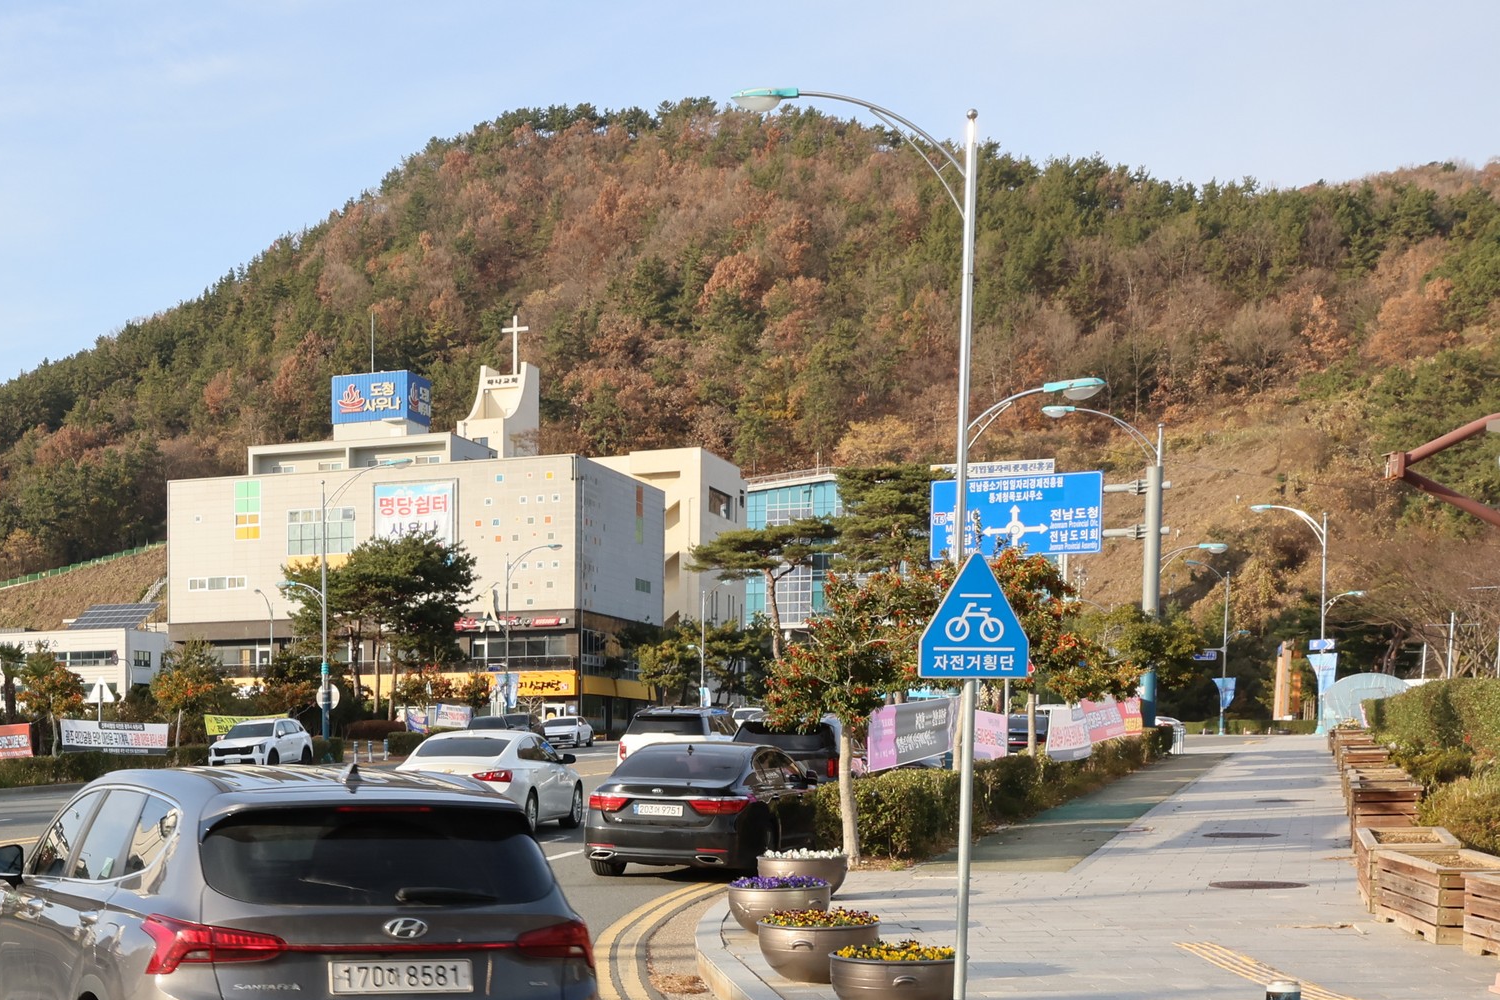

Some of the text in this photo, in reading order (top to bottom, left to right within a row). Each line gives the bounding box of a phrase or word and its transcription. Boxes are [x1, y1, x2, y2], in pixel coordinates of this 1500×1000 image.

[370, 382, 395, 397] 도청
[363, 397, 401, 412] 사우나
[379, 494, 447, 516] 명당쉼터
[988, 491, 1043, 504] 통계청목포사무소
[1050, 506, 1098, 521] 전남도청
[1049, 528, 1098, 543] 전남도의회
[933, 654, 1014, 671] 자전거횡단
[662, 806, 680, 815] 9751
[406, 965, 461, 987] 8581
